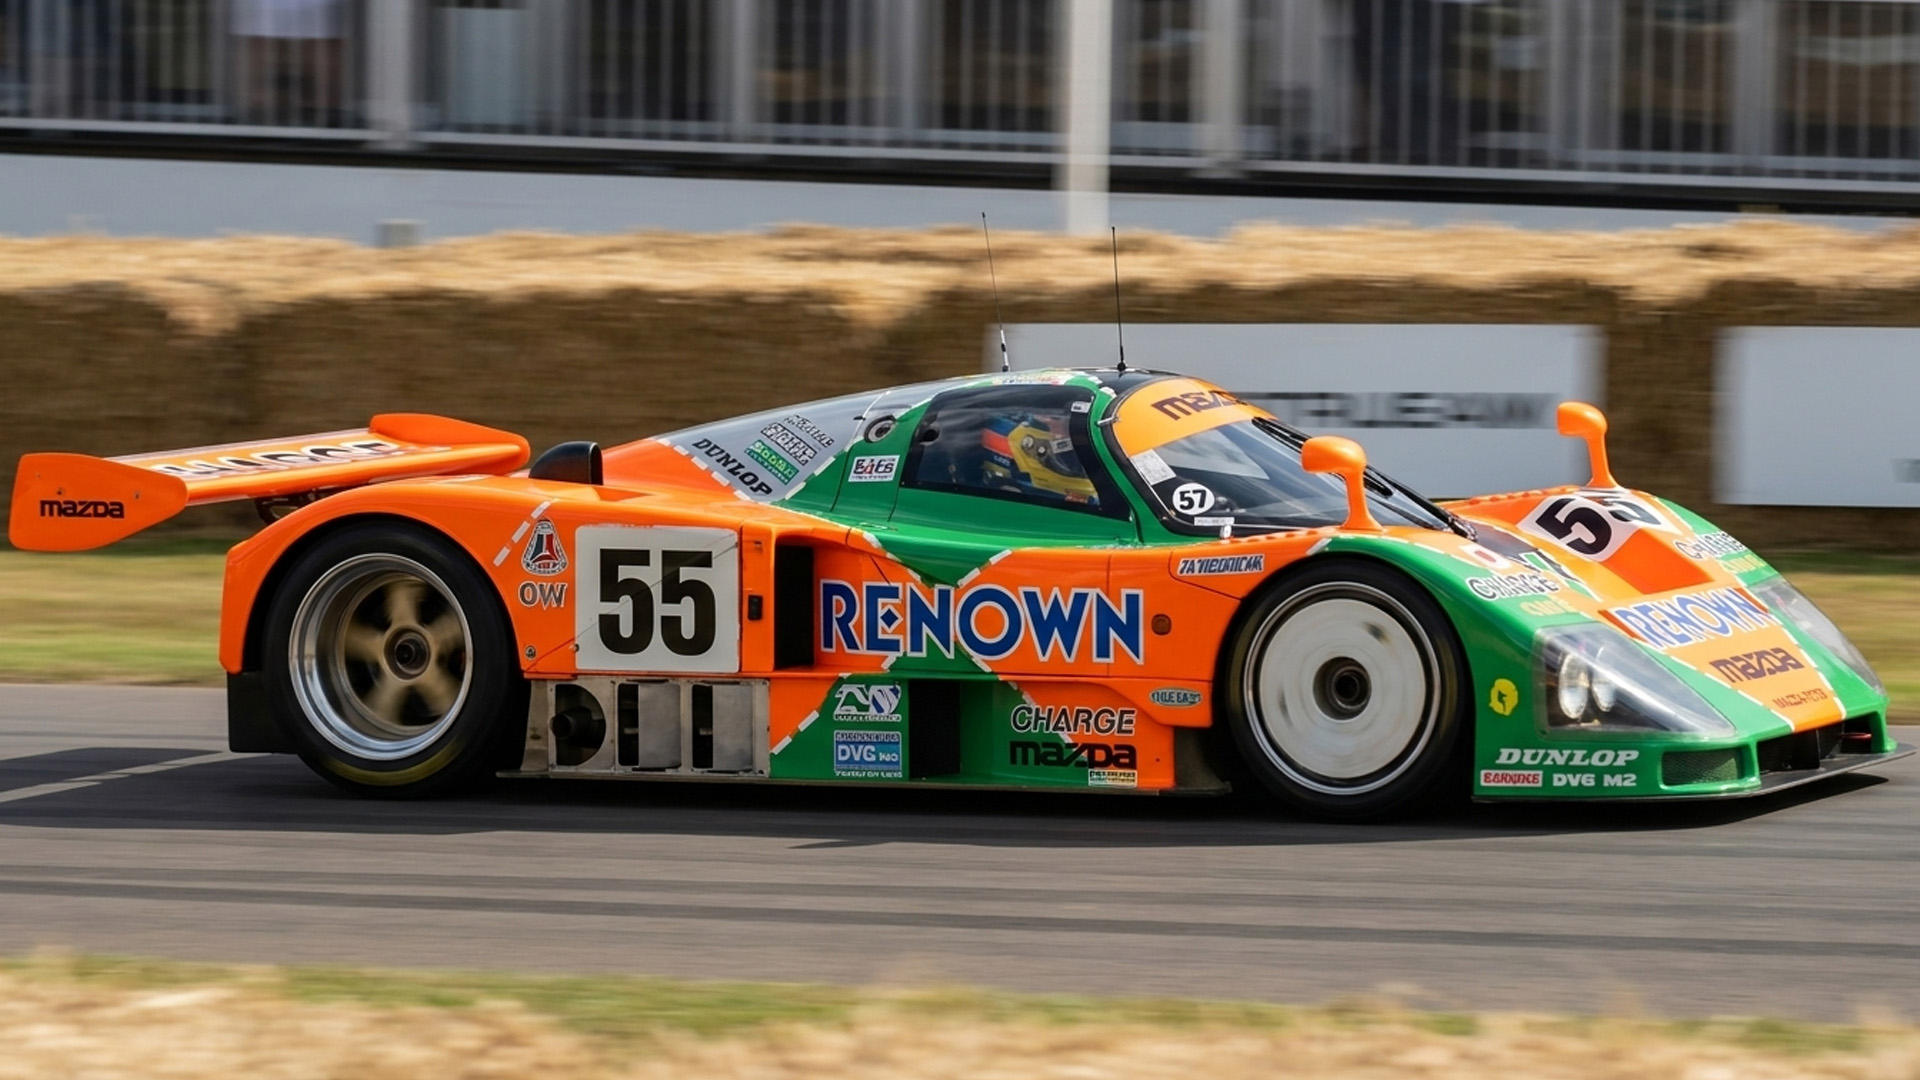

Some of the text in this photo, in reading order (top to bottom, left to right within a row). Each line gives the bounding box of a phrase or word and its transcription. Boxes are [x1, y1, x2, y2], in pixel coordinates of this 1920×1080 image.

[692, 438, 773, 497] DUNLOP
[1179, 489, 1207, 511] 57
[518, 581, 568, 610] OW
[597, 547, 717, 657] 55
[819, 579, 1144, 665] RENOWN
[1611, 586, 1773, 650] RENOWN
[1011, 704, 1137, 736] CHARGE
[1495, 748, 1640, 767] DUNLOP
[1603, 773, 1637, 787] M2
